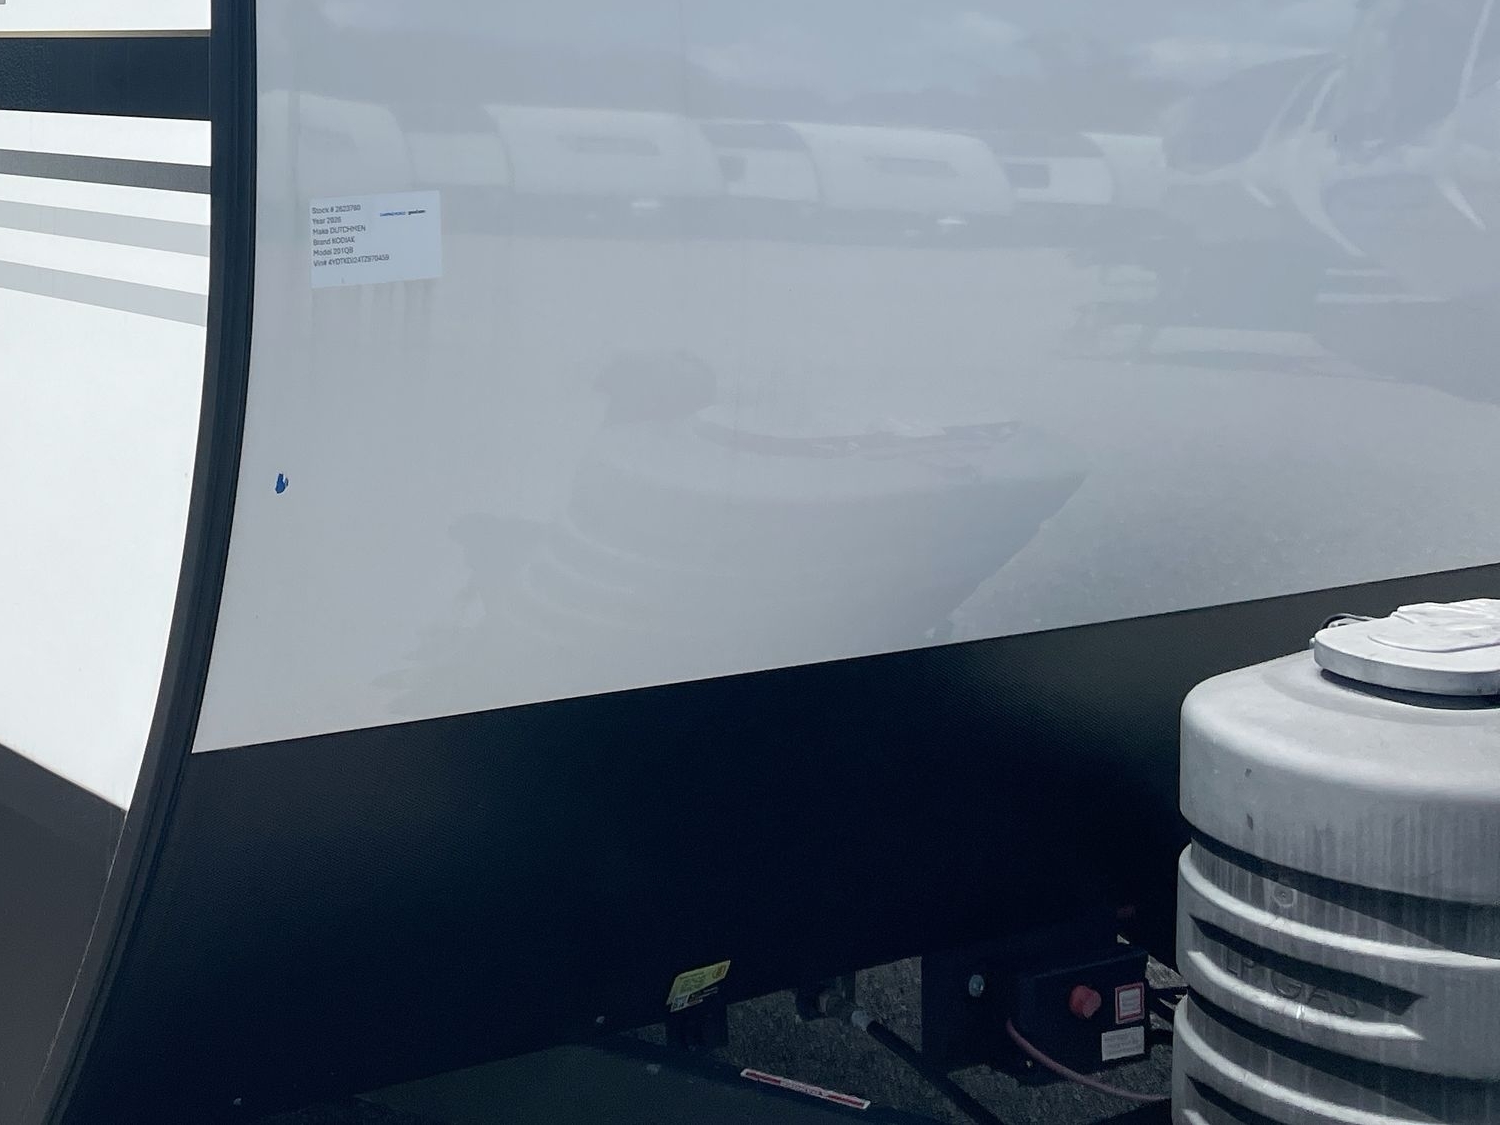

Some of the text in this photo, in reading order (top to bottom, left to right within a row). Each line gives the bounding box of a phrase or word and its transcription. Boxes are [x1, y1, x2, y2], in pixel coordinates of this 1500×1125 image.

[311, 206, 329, 214] Stock
[311, 218, 326, 226] Year
[312, 225, 366, 236] Make DUTCHMEN
[312, 236, 355, 246] Brand KODIAK
[312, 248, 332, 256] Model
